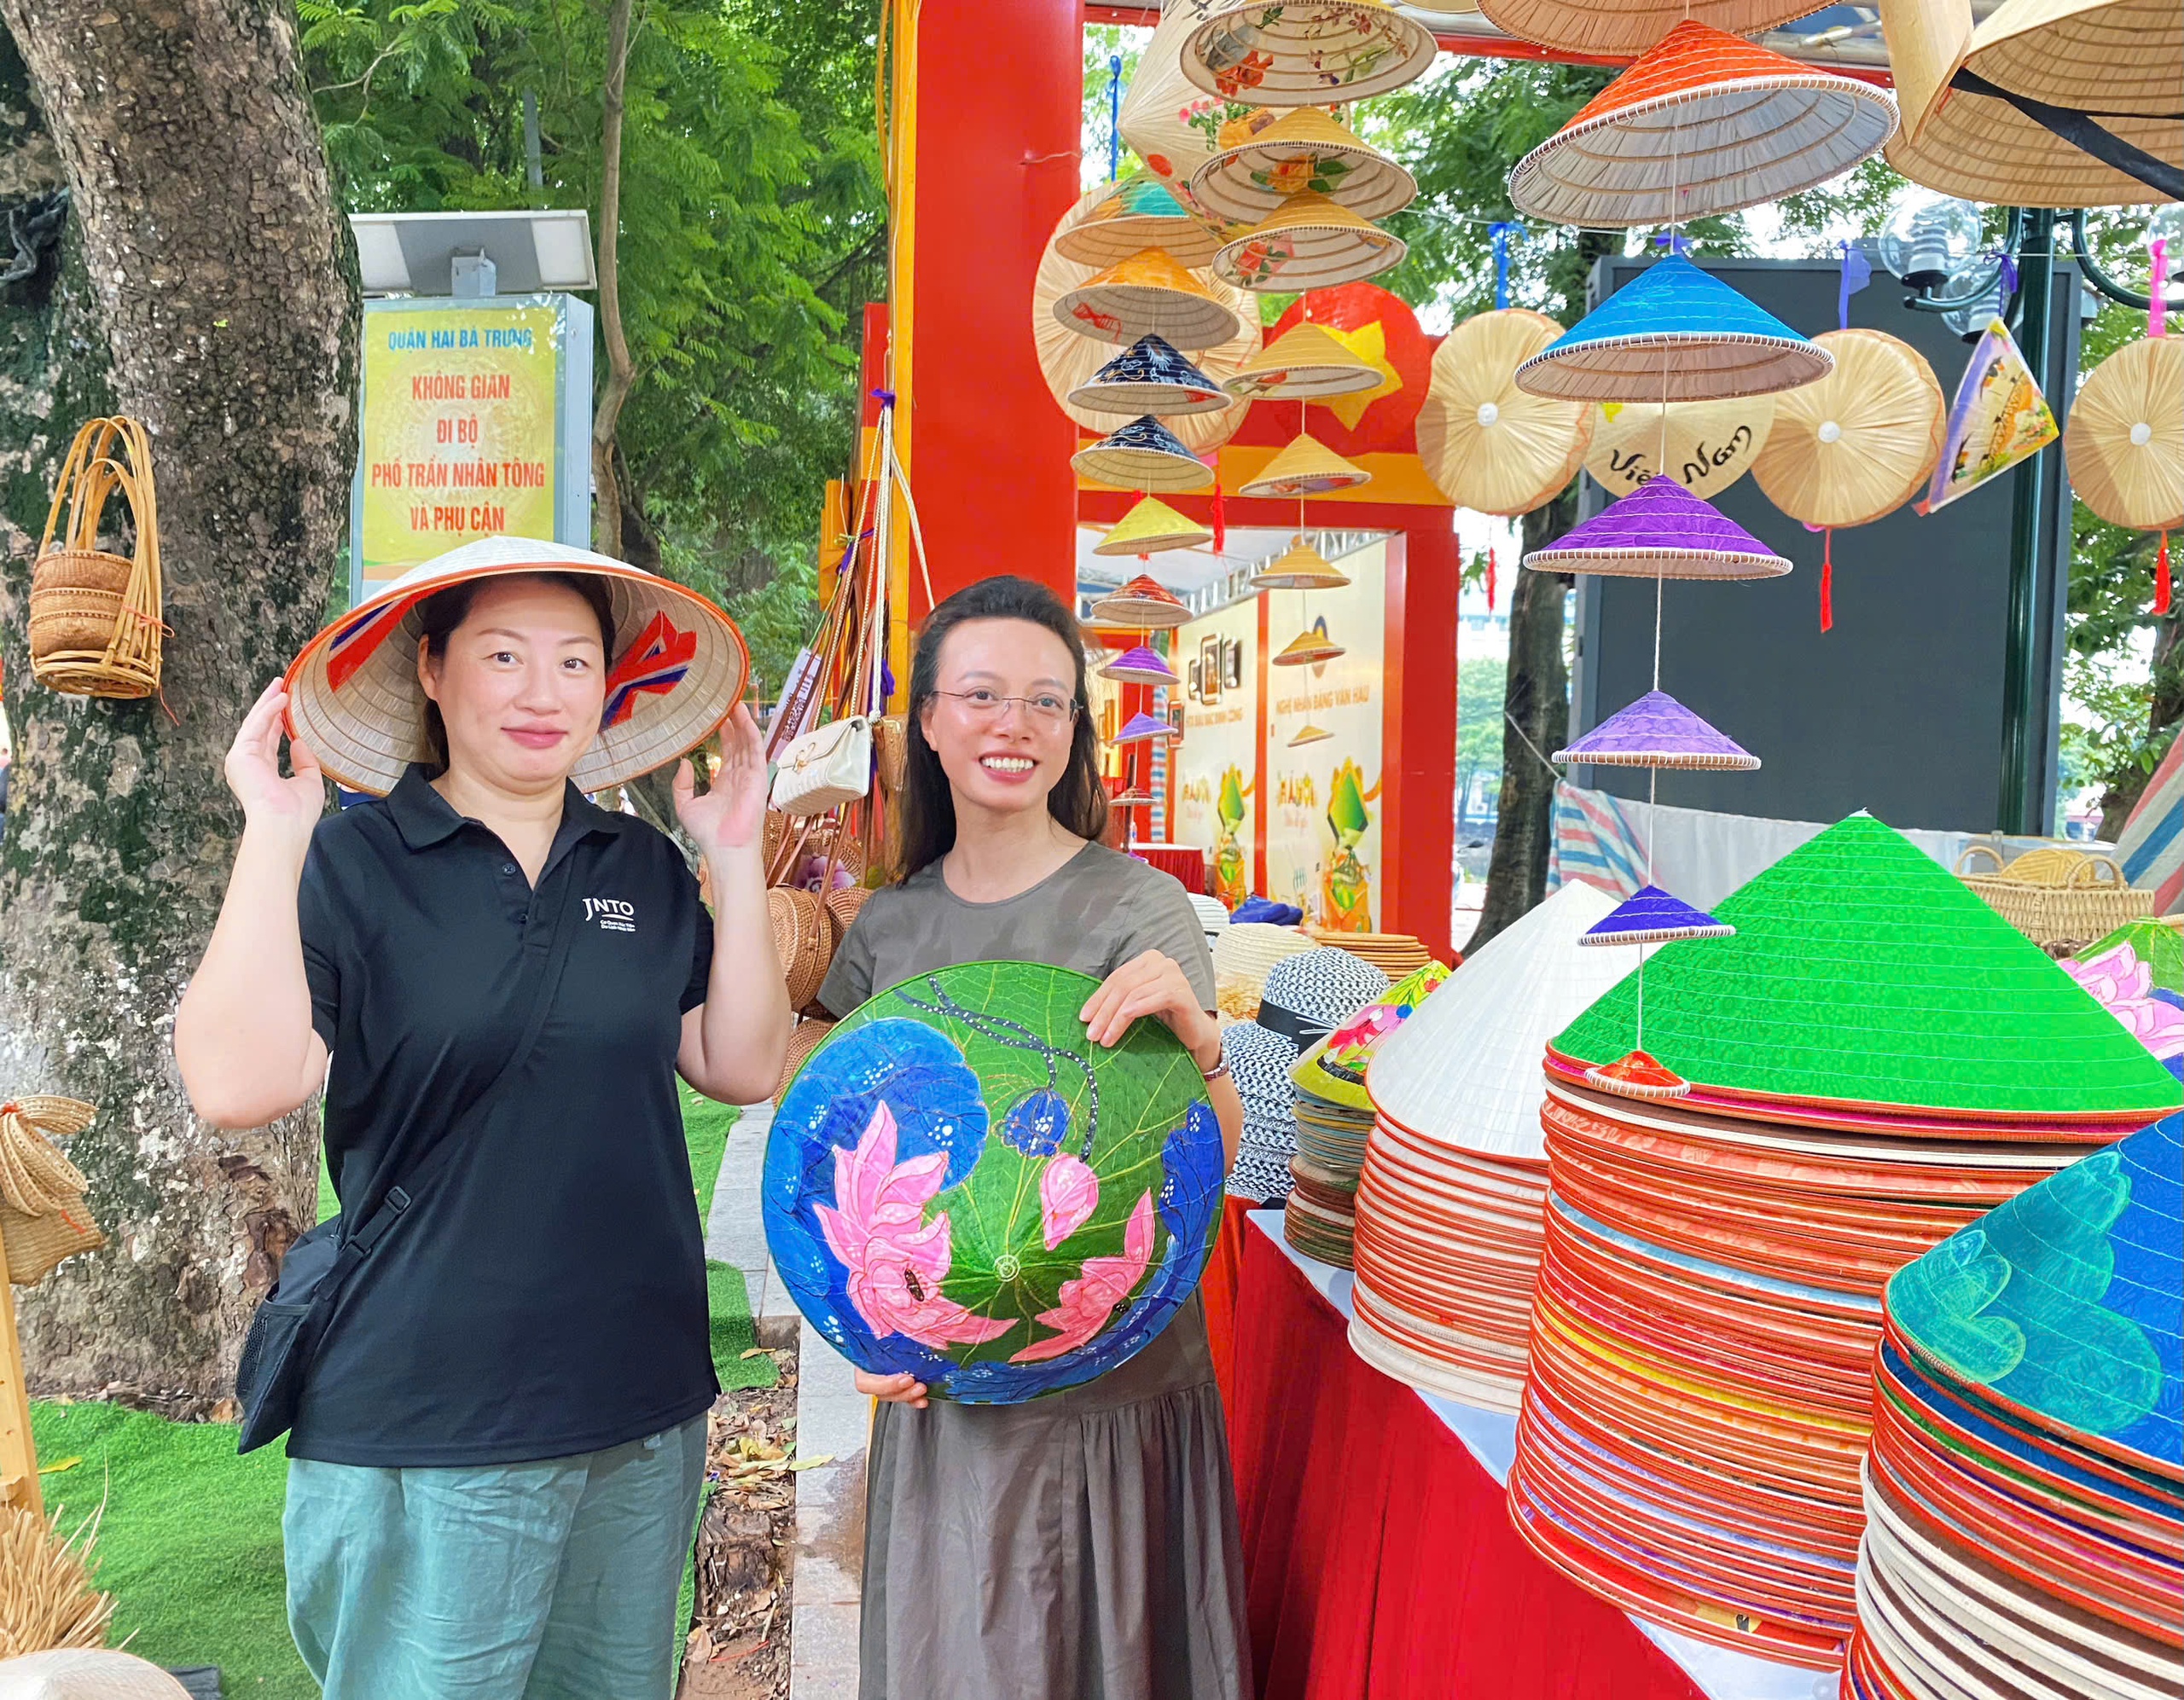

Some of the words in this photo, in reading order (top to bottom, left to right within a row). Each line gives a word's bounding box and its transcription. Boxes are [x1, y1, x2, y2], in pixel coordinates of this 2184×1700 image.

[388, 326, 427, 354] QUẬN
[431, 330, 456, 349] HAI
[412, 369, 466, 401] KHÔNG
[471, 374, 510, 400] GIAN
[437, 419, 453, 444] ĐI
[457, 413, 479, 450] BỘ
[371, 454, 403, 488] PHỐ
[452, 457, 497, 488] NHÂN
[502, 457, 545, 488] TÔNG
[1682, 425, 1752, 484] Nam
[433, 506, 466, 538] PHỤ
[470, 500, 505, 538] CẬN
[582, 897, 635, 921] JNTO
